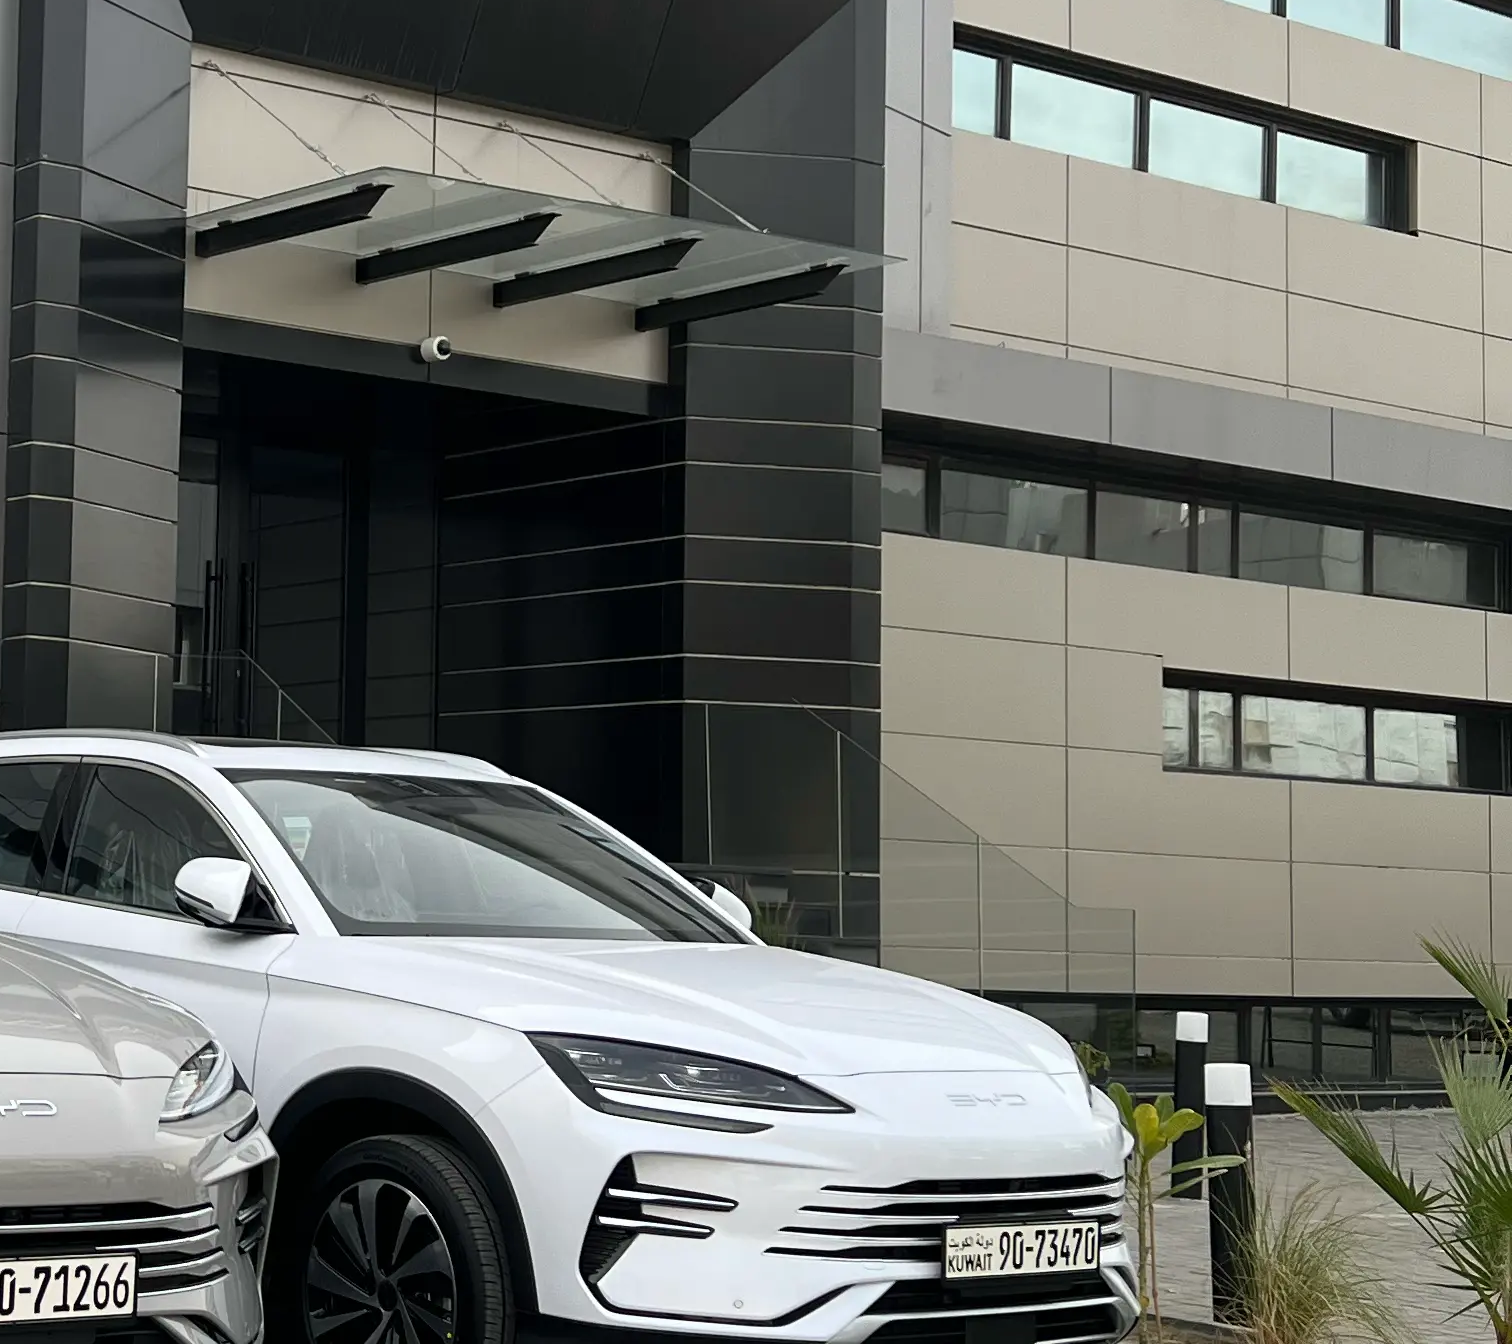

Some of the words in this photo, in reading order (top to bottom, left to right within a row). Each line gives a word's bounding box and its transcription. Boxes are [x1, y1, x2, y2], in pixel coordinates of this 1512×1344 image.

[945, 1092, 1028, 1107] BYD
[975, 1233, 994, 1250] دولة
[999, 1226, 1096, 1271] 90-73470
[947, 1253, 994, 1273] KUWAIT
